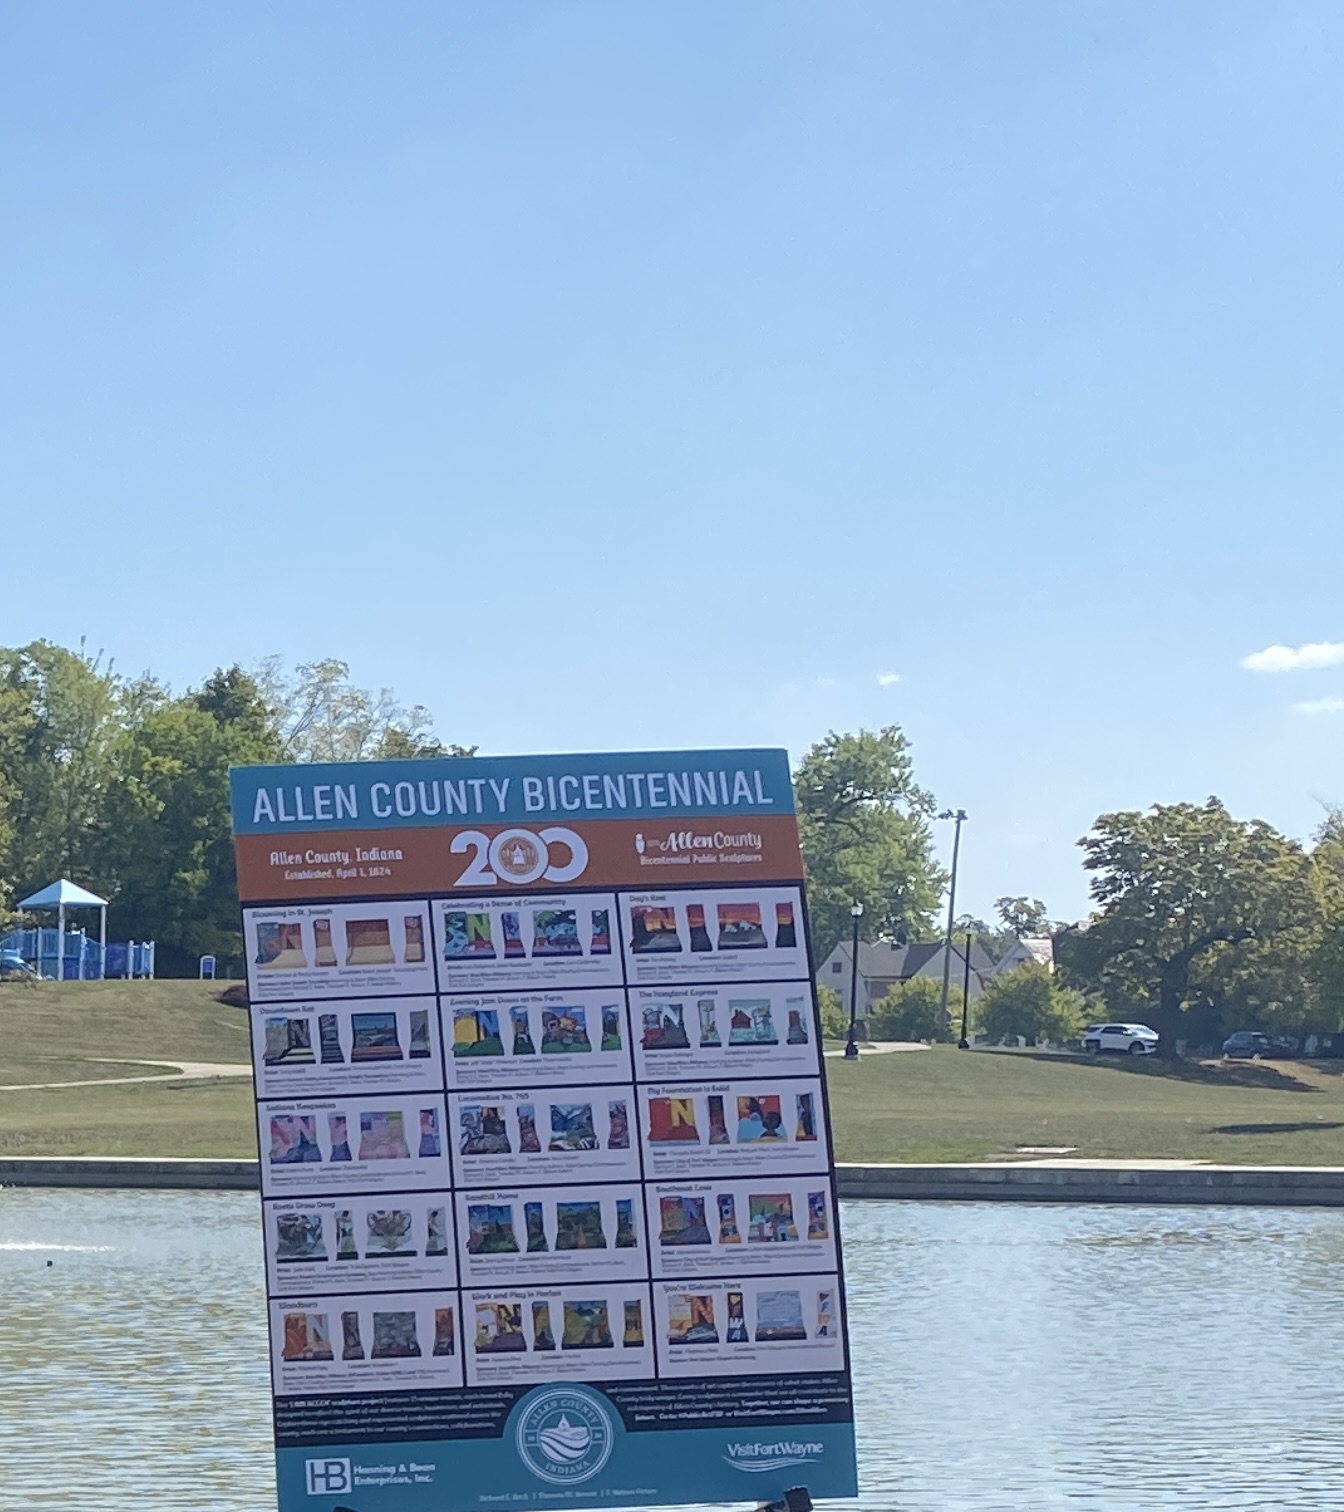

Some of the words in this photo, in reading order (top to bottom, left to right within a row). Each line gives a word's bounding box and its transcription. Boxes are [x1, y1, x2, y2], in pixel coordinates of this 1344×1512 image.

[253, 784, 358, 823] ALLEN
[370, 778, 511, 818] COUNTY
[522, 770, 773, 812] BICENTENNIAL
[270, 850, 302, 866] Allen
[355, 847, 403, 862] Indiana
[449, 826, 589, 888] 200
[640, 854, 690, 865] Bicentennial
[693, 853, 716, 864] Public
[336, 867, 357, 879] April
[369, 866, 392, 877] 1824
[531, 1400, 558, 1425] ALLEN
[560, 1399, 598, 1424] COUNTY
[398, 1463, 406, 1472] &
[545, 1460, 590, 1475] INDIANA
[309, 1461, 348, 1492] HB
[414, 1473, 433, 1482] Inc.
